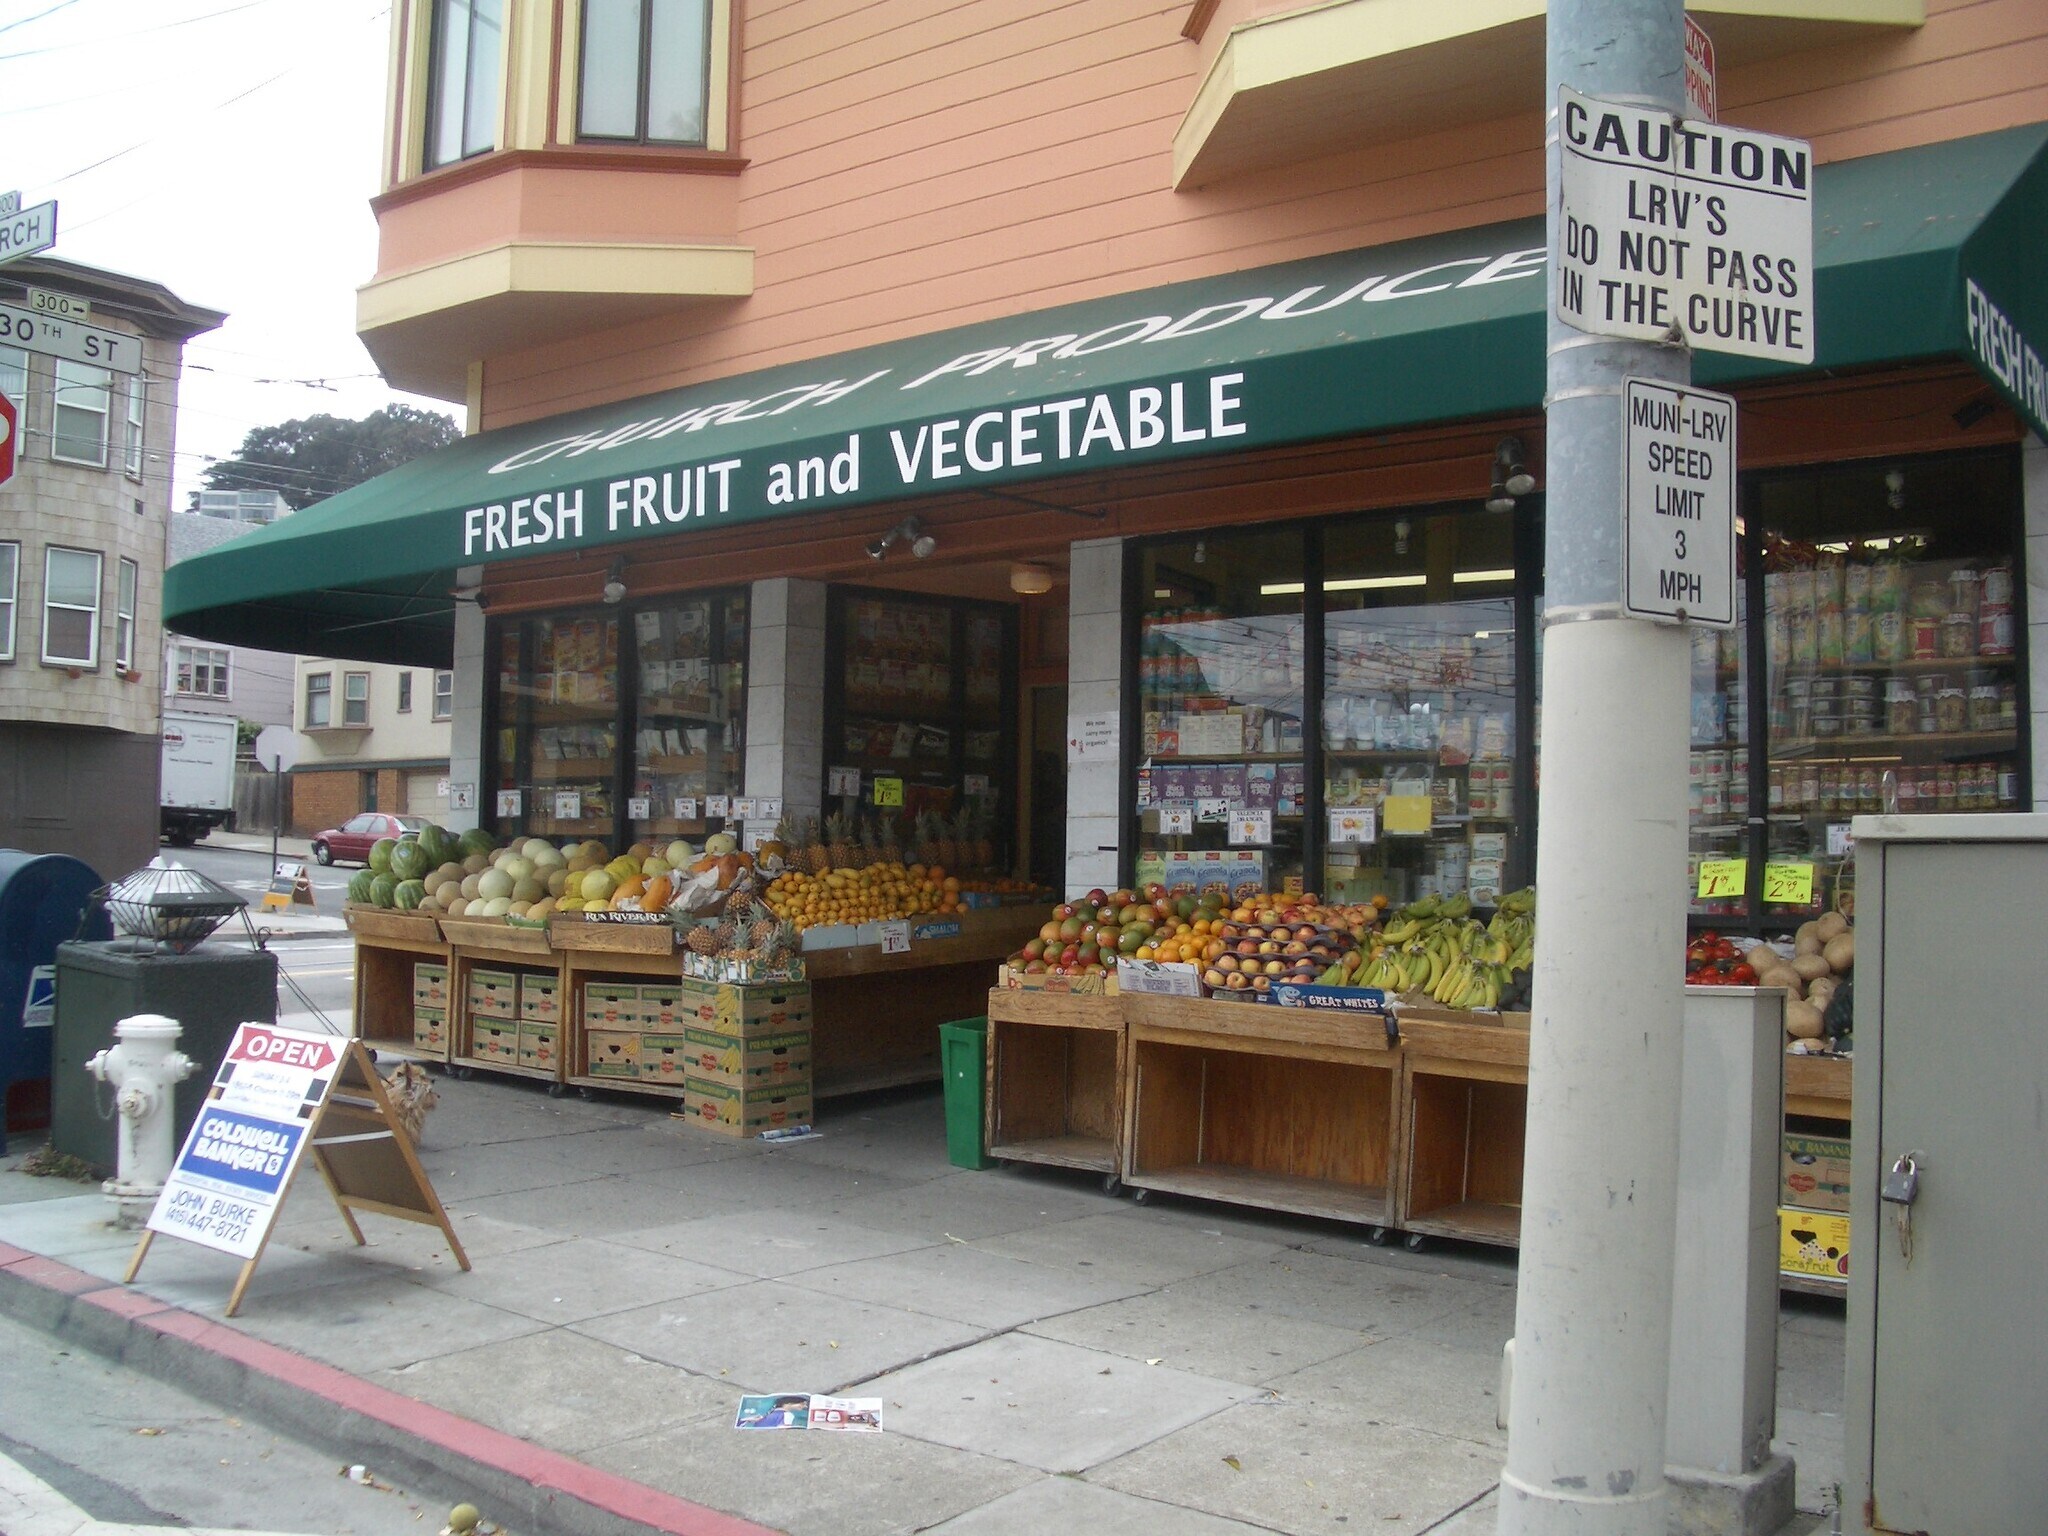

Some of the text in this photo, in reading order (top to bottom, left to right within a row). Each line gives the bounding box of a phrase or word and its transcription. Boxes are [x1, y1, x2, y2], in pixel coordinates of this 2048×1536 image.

[1566, 101, 1807, 191] CAUTION
[1628, 180, 1727, 236] LRV'S
[1567, 215, 1798, 298] DO NOT PASS
[36, 293, 69, 314] 300
[1563, 266, 1803, 349] IN THE CURVE
[84, 334, 119, 362] ST
[1966, 277, 2023, 400] FRESH
[487, 246, 1547, 475] CHURCH PRODUCE
[1633, 396, 1727, 443] MUNI-LRV
[463, 372, 1248, 557] FRESH FRUIT and VEGETABLE
[1648, 441, 1712, 480] SPEED
[1655, 485, 1704, 520] LIMIT
[1675, 530, 1687, 560] 3
[1660, 569, 1701, 603] MPH
[1166, 866, 1196, 878] Granola
[1230, 866, 1261, 880] Granola
[1308, 995, 1379, 1009] GREAT WHITES
[246, 1035, 324, 1067] OPEN
[170, 1190, 258, 1225] JOHN BURKE
